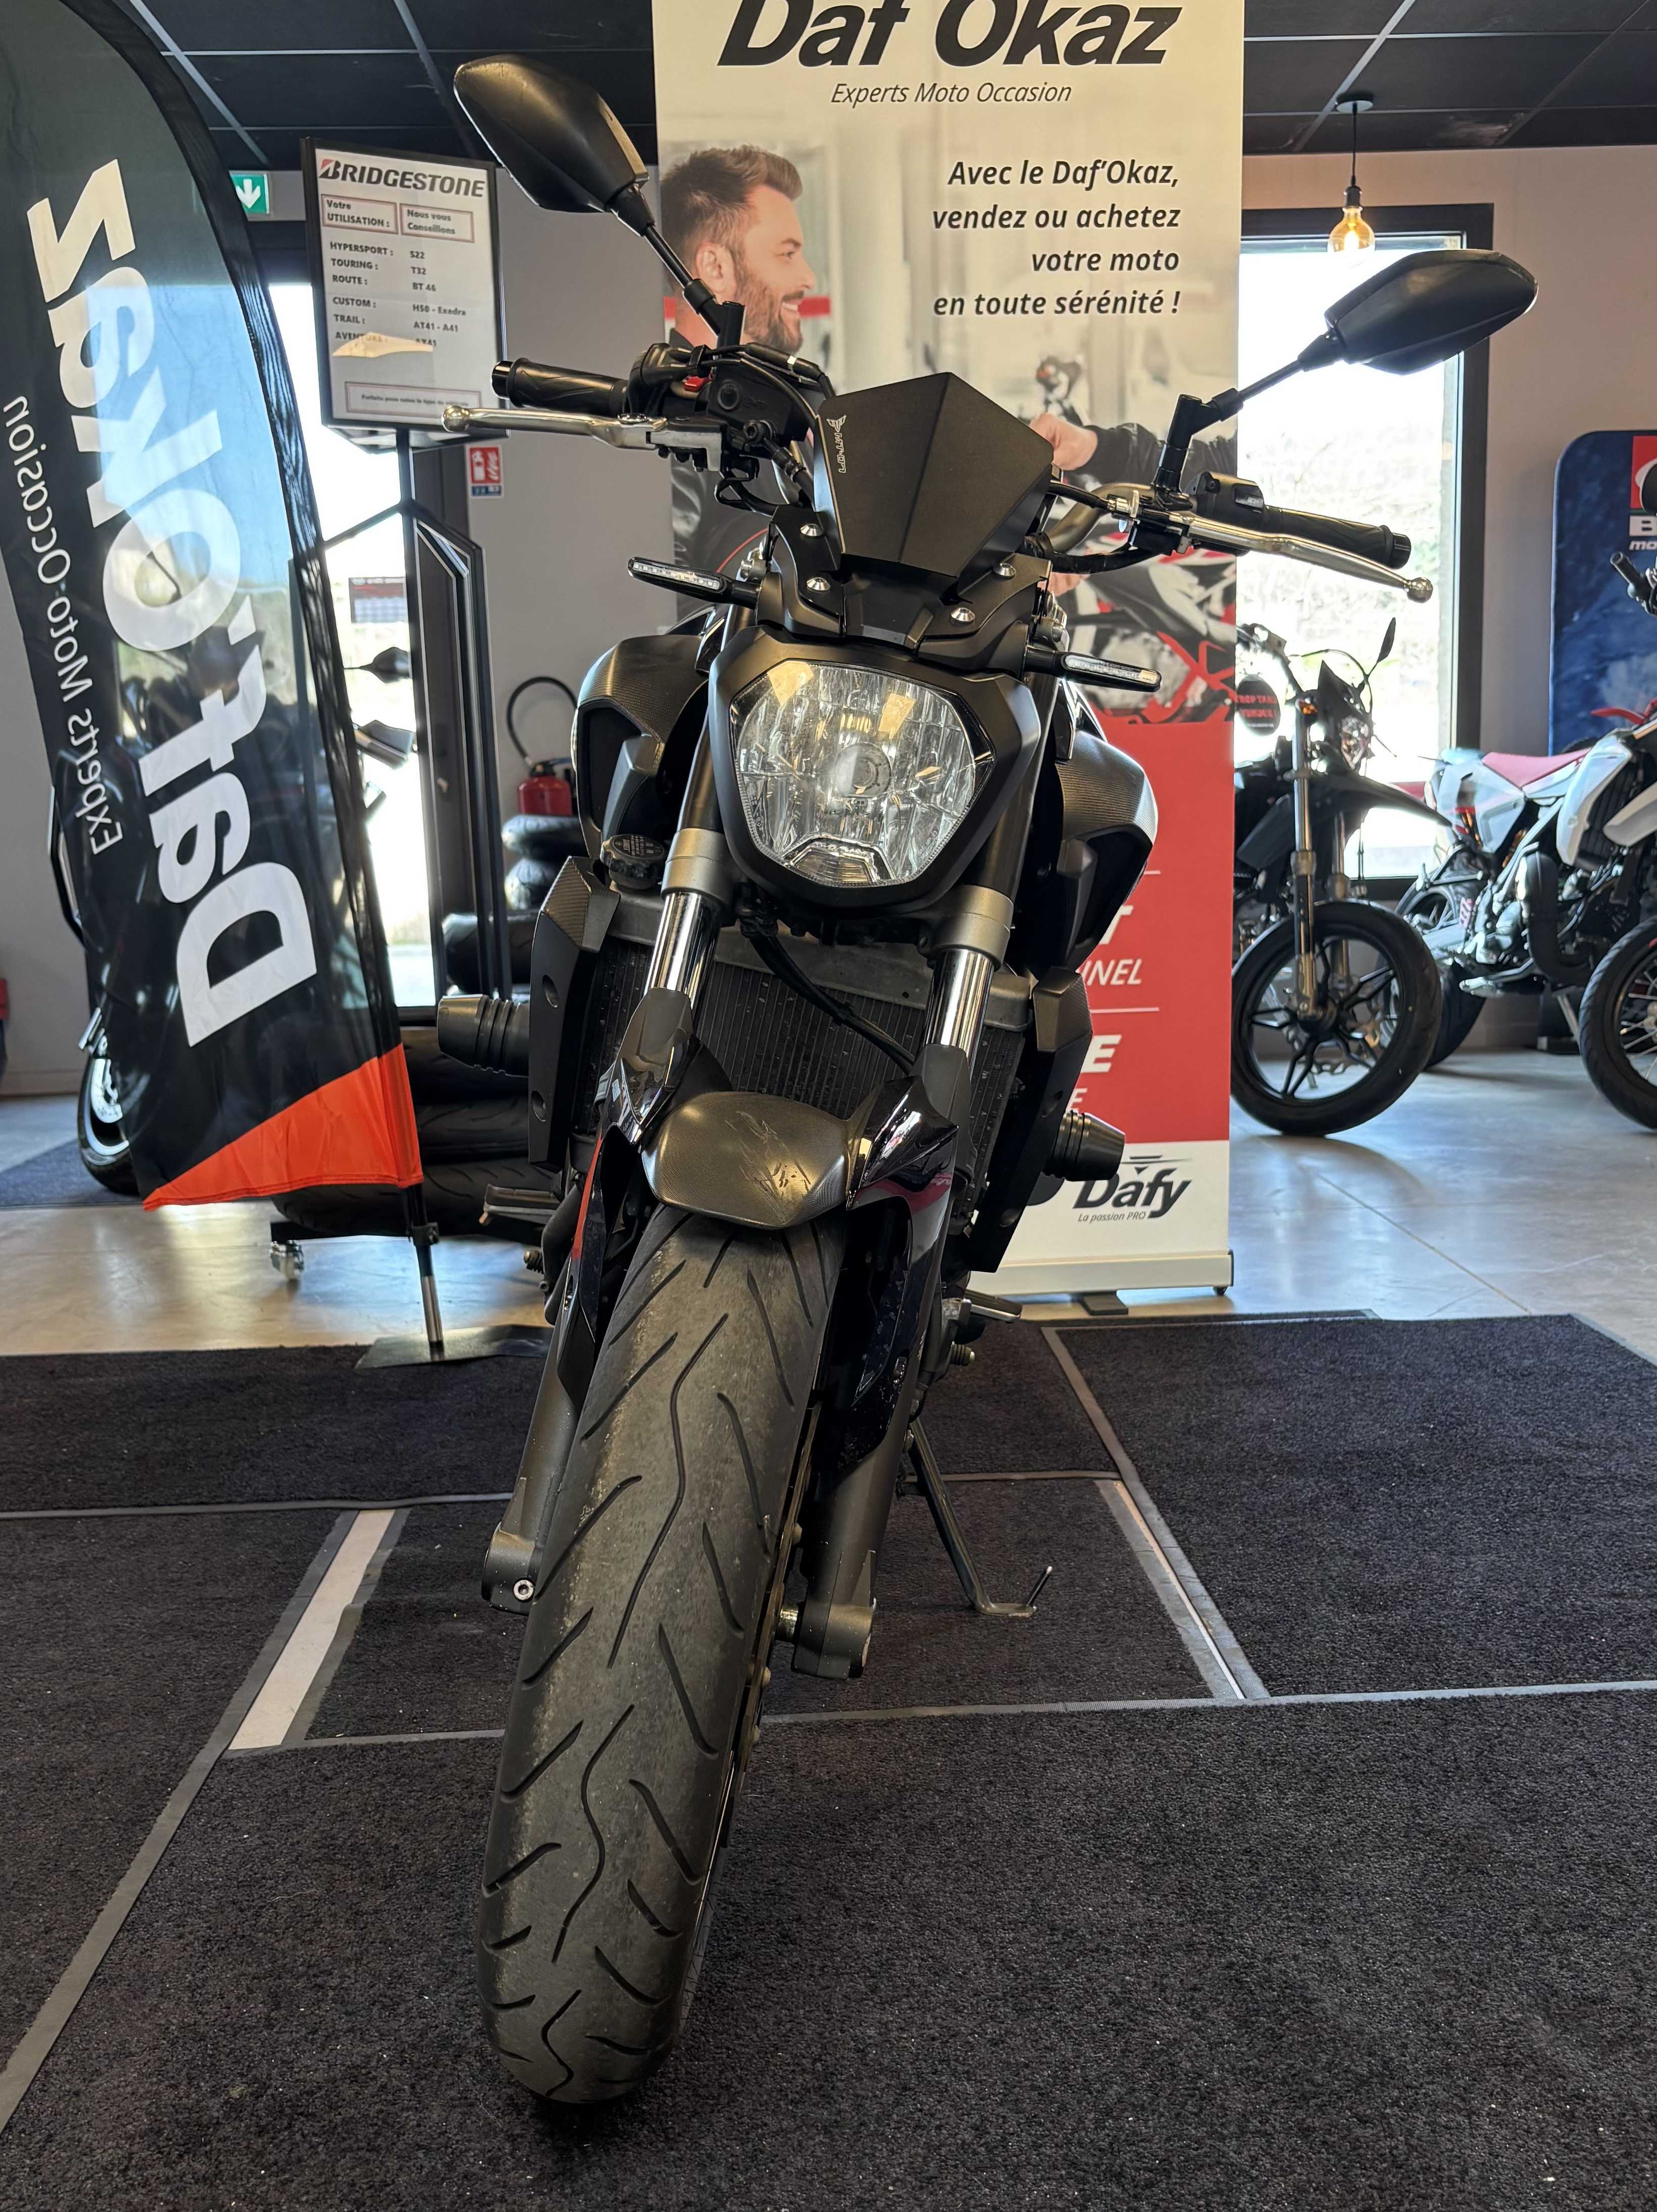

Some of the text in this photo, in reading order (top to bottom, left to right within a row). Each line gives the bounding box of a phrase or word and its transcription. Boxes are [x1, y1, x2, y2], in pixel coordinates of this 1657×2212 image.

[831, 82, 1071, 109] Experts Moto Occasion
[319, 159, 486, 197] BRIDGESTONE
[948, 162, 1012, 185] Avec
[1020, 160, 1044, 184] le
[326, 199, 351, 210] Votre
[407, 209, 451, 221] Nous vous
[933, 203, 1181, 229] vendez ou achetez
[331, 258, 373, 269] TOURING
[410, 266, 426, 275] T32
[1032, 249, 1179, 271] votre moto
[332, 275, 363, 285] ROUTE
[412, 282, 423, 290] BT
[333, 296, 371, 307] CUSTOM
[934, 297, 964, 315] en
[975, 293, 1046, 315] toute
[1054, 289, 1164, 314] sérénité
[334, 314, 360, 324] TRAIL
[1073, 1167, 1192, 1219] Dafy
[1078, 1211, 1146, 1224] La passion PRO
